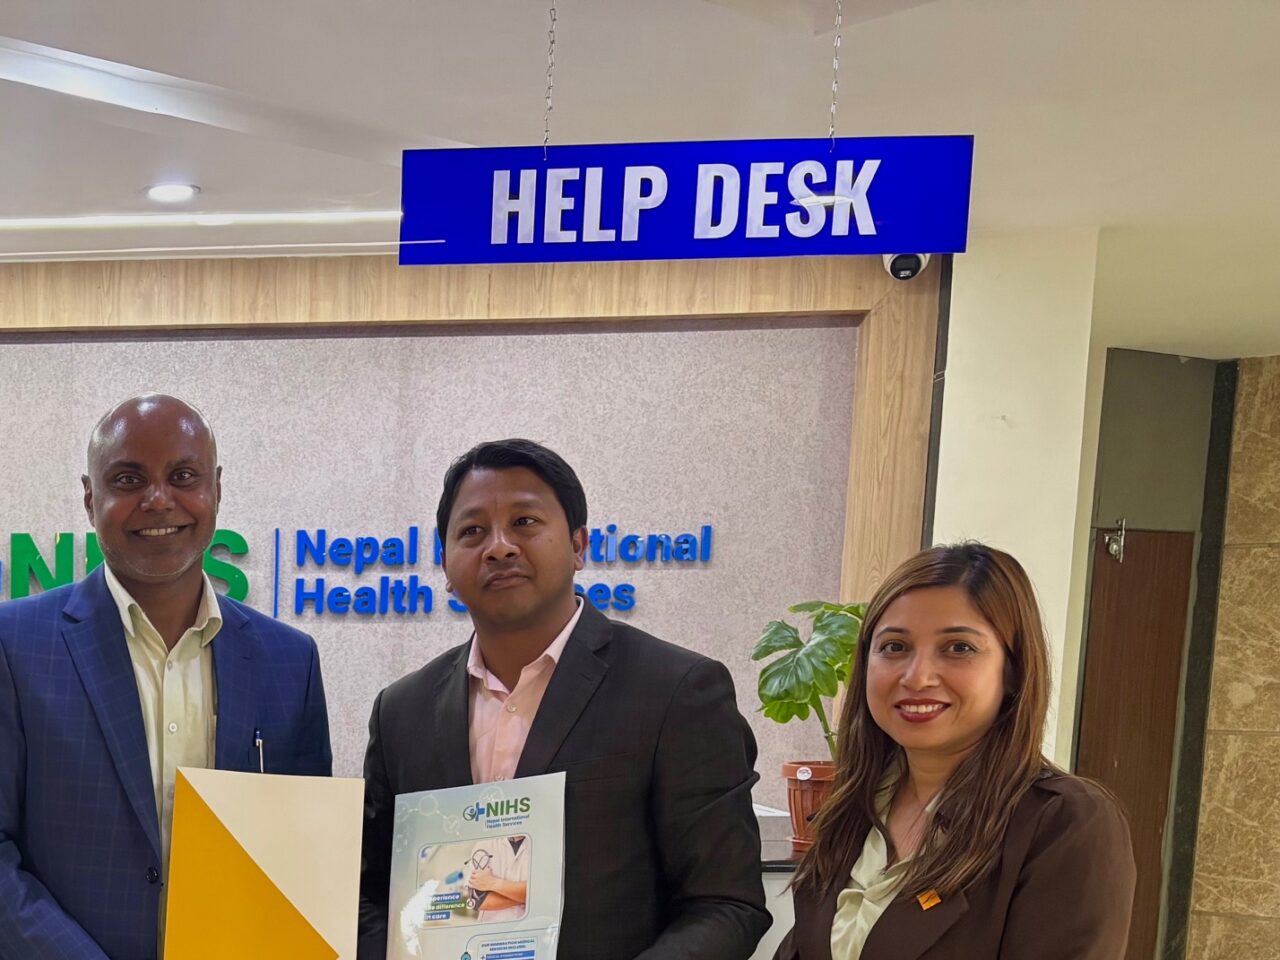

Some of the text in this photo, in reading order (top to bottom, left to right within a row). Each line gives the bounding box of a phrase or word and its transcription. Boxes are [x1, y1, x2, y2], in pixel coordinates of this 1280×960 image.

[491, 159, 881, 244] HELP DESK
[10, 529, 250, 602] NS
[296, 526, 418, 574] Nepal
[295, 575, 433, 616] Health
[486, 797, 531, 818] NIHS
